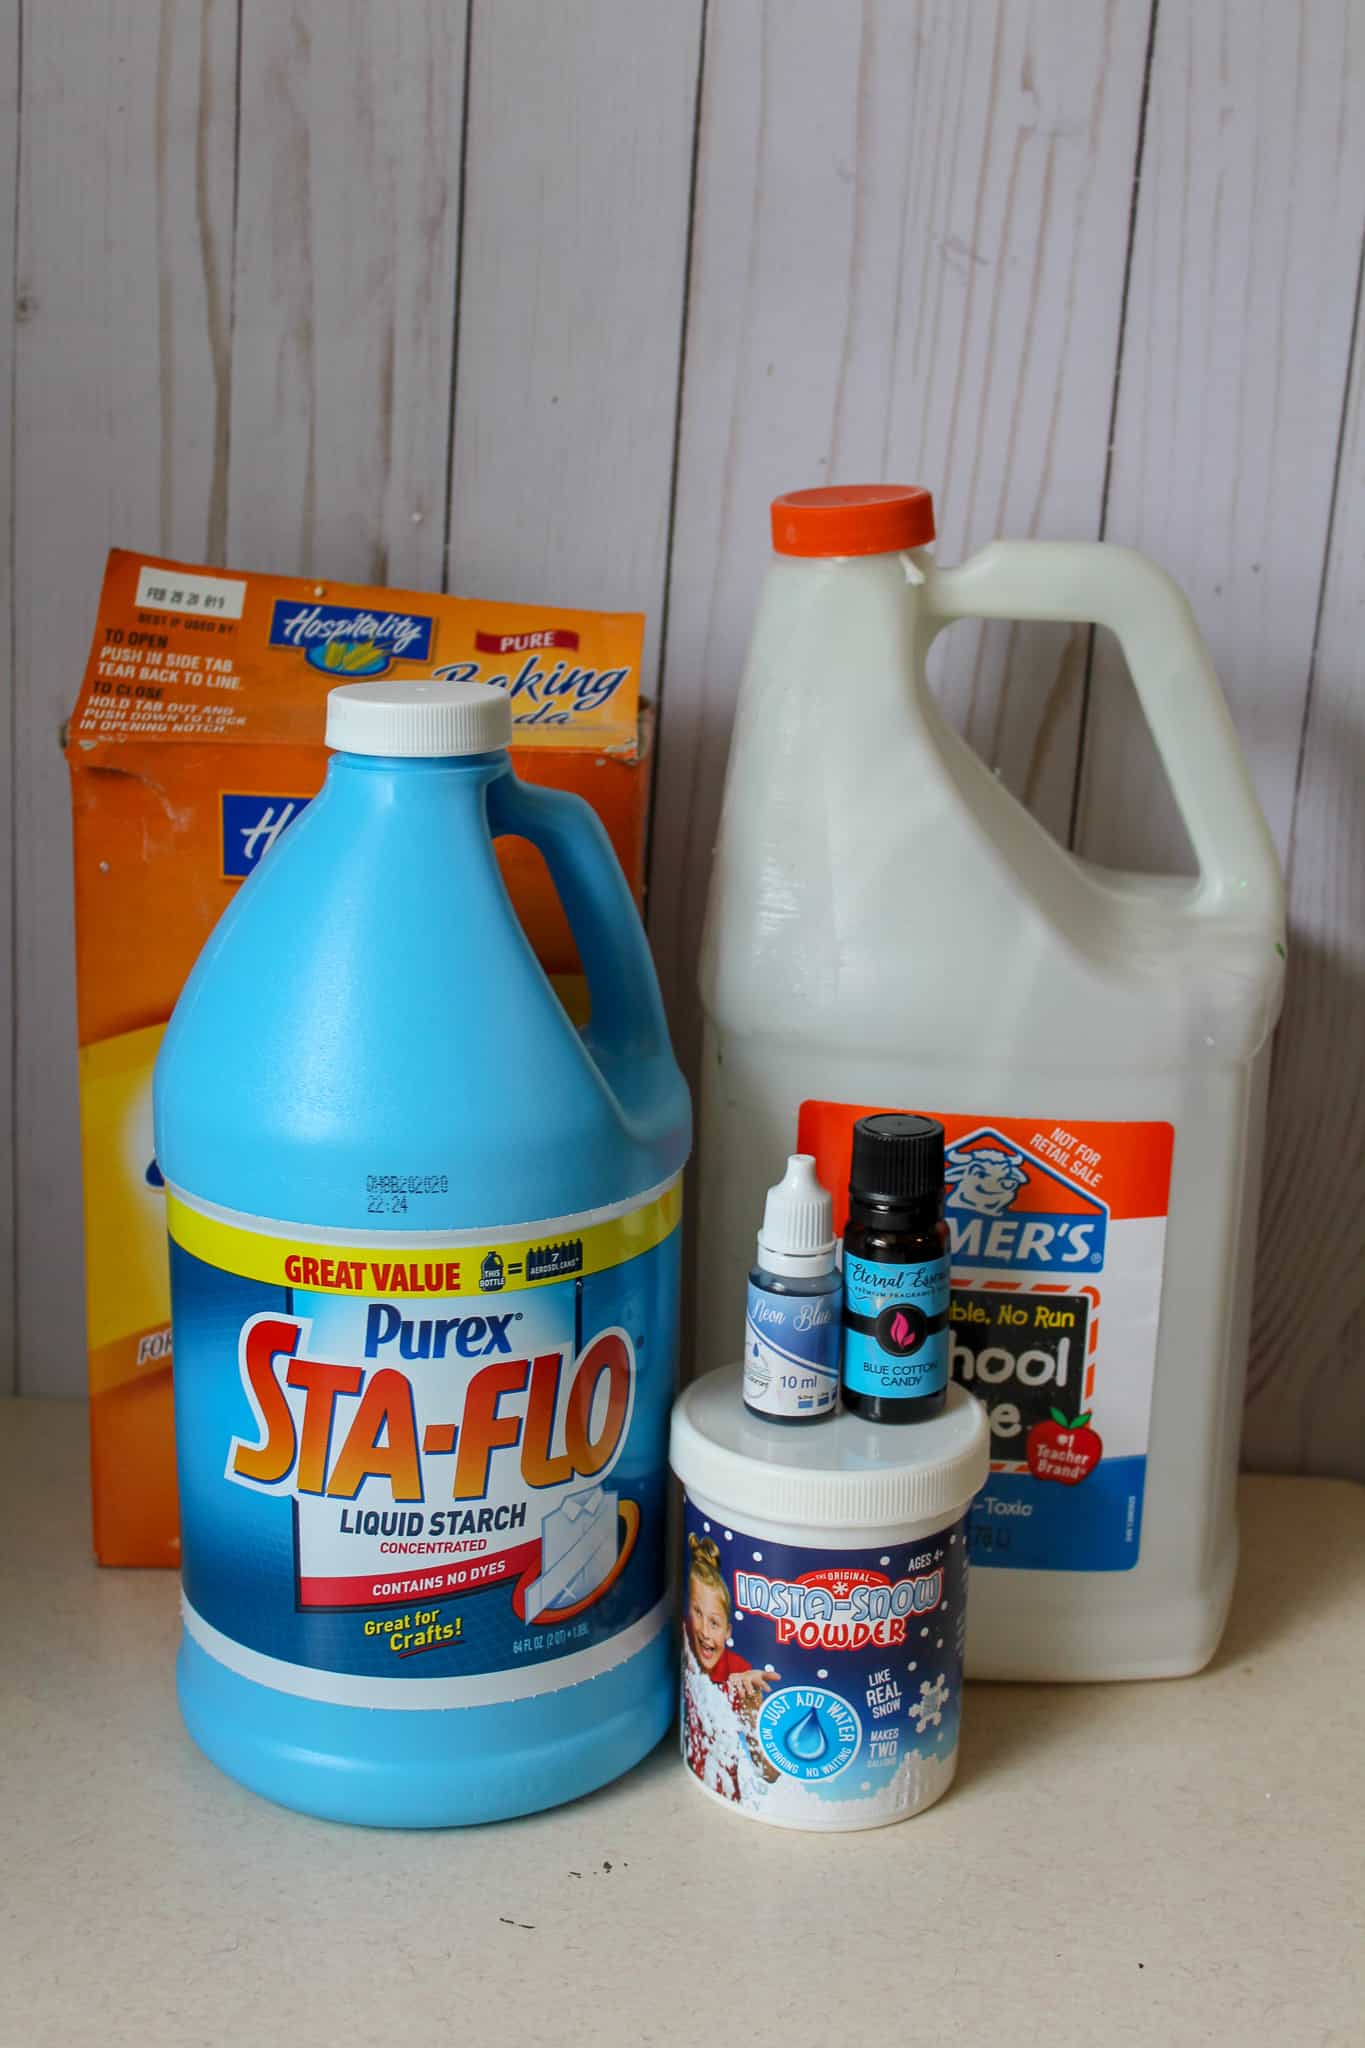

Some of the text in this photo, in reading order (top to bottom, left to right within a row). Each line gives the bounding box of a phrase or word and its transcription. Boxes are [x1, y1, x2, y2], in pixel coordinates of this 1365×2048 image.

[104, 628, 168, 649] TO OPEN
[284, 606, 424, 653] Hospitality
[501, 632, 555, 652] PURE
[100, 646, 233, 673] PUSH IN SIDE TAB
[97, 661, 136, 679] TEAR
[139, 666, 179, 684] BACK
[183, 671, 203, 686] TO
[93, 680, 164, 699] TO CLOSE
[83, 708, 126, 721] PUSH
[130, 711, 179, 722] DOWN
[88, 696, 235, 716] HOLD TAB OUT AND
[79, 720, 226, 734] IN OPENING NOTCH
[1049, 1127, 1102, 1168] NOT FOR
[1030, 1133, 1103, 1188] RETAIL SALE
[367, 1195, 409, 1214] 22:24
[551, 1253, 560, 1263] 7
[284, 1254, 462, 1293] GREAT VALUE
[485, 1269, 501, 1278] THIS
[530, 1264, 559, 1275] AEROSOL
[849, 1261, 904, 1290] Eternal
[480, 1278, 505, 1287] BOTTLE
[752, 1299, 786, 1325] Neon
[997, 1303, 1028, 1326] No
[1033, 1305, 1076, 1329] Run
[863, 1361, 937, 1376] BLUE COTTON
[948, 1328, 1072, 1388] hool
[781, 1375, 797, 1389] 10
[801, 1375, 817, 1389] ml
[881, 1375, 921, 1387] CANDY
[231, 1317, 632, 1505] STA-FLO
[1037, 1443, 1090, 1465] Teacher
[974, 1496, 1034, 1517] -Toxic
[339, 1502, 527, 1537] LIQUID STARCH
[379, 1538, 487, 1554] CONCENTRATED
[908, 1553, 931, 1571] AGES
[371, 1560, 506, 1597] CONTAINS NO DYES
[827, 1571, 870, 1583] ORIGINAL
[736, 1570, 942, 1623] INSTA-SNOW
[363, 1608, 441, 1637] Great for
[778, 1617, 906, 1648] POWDER
[389, 1617, 463, 1652] Crafts!
[868, 1668, 892, 1687] LIKE
[865, 1681, 902, 1708] REAL
[763, 1692, 856, 1743] JUST ADD WATER
[871, 1702, 901, 1719] SNOW
[761, 1727, 773, 1741] NO
[870, 1727, 899, 1743] MAKES
[765, 1741, 800, 1775] STIRRING
[869, 1741, 898, 1759] TWO
[822, 1747, 852, 1776] WAITING
[806, 1767, 820, 1778] NO
